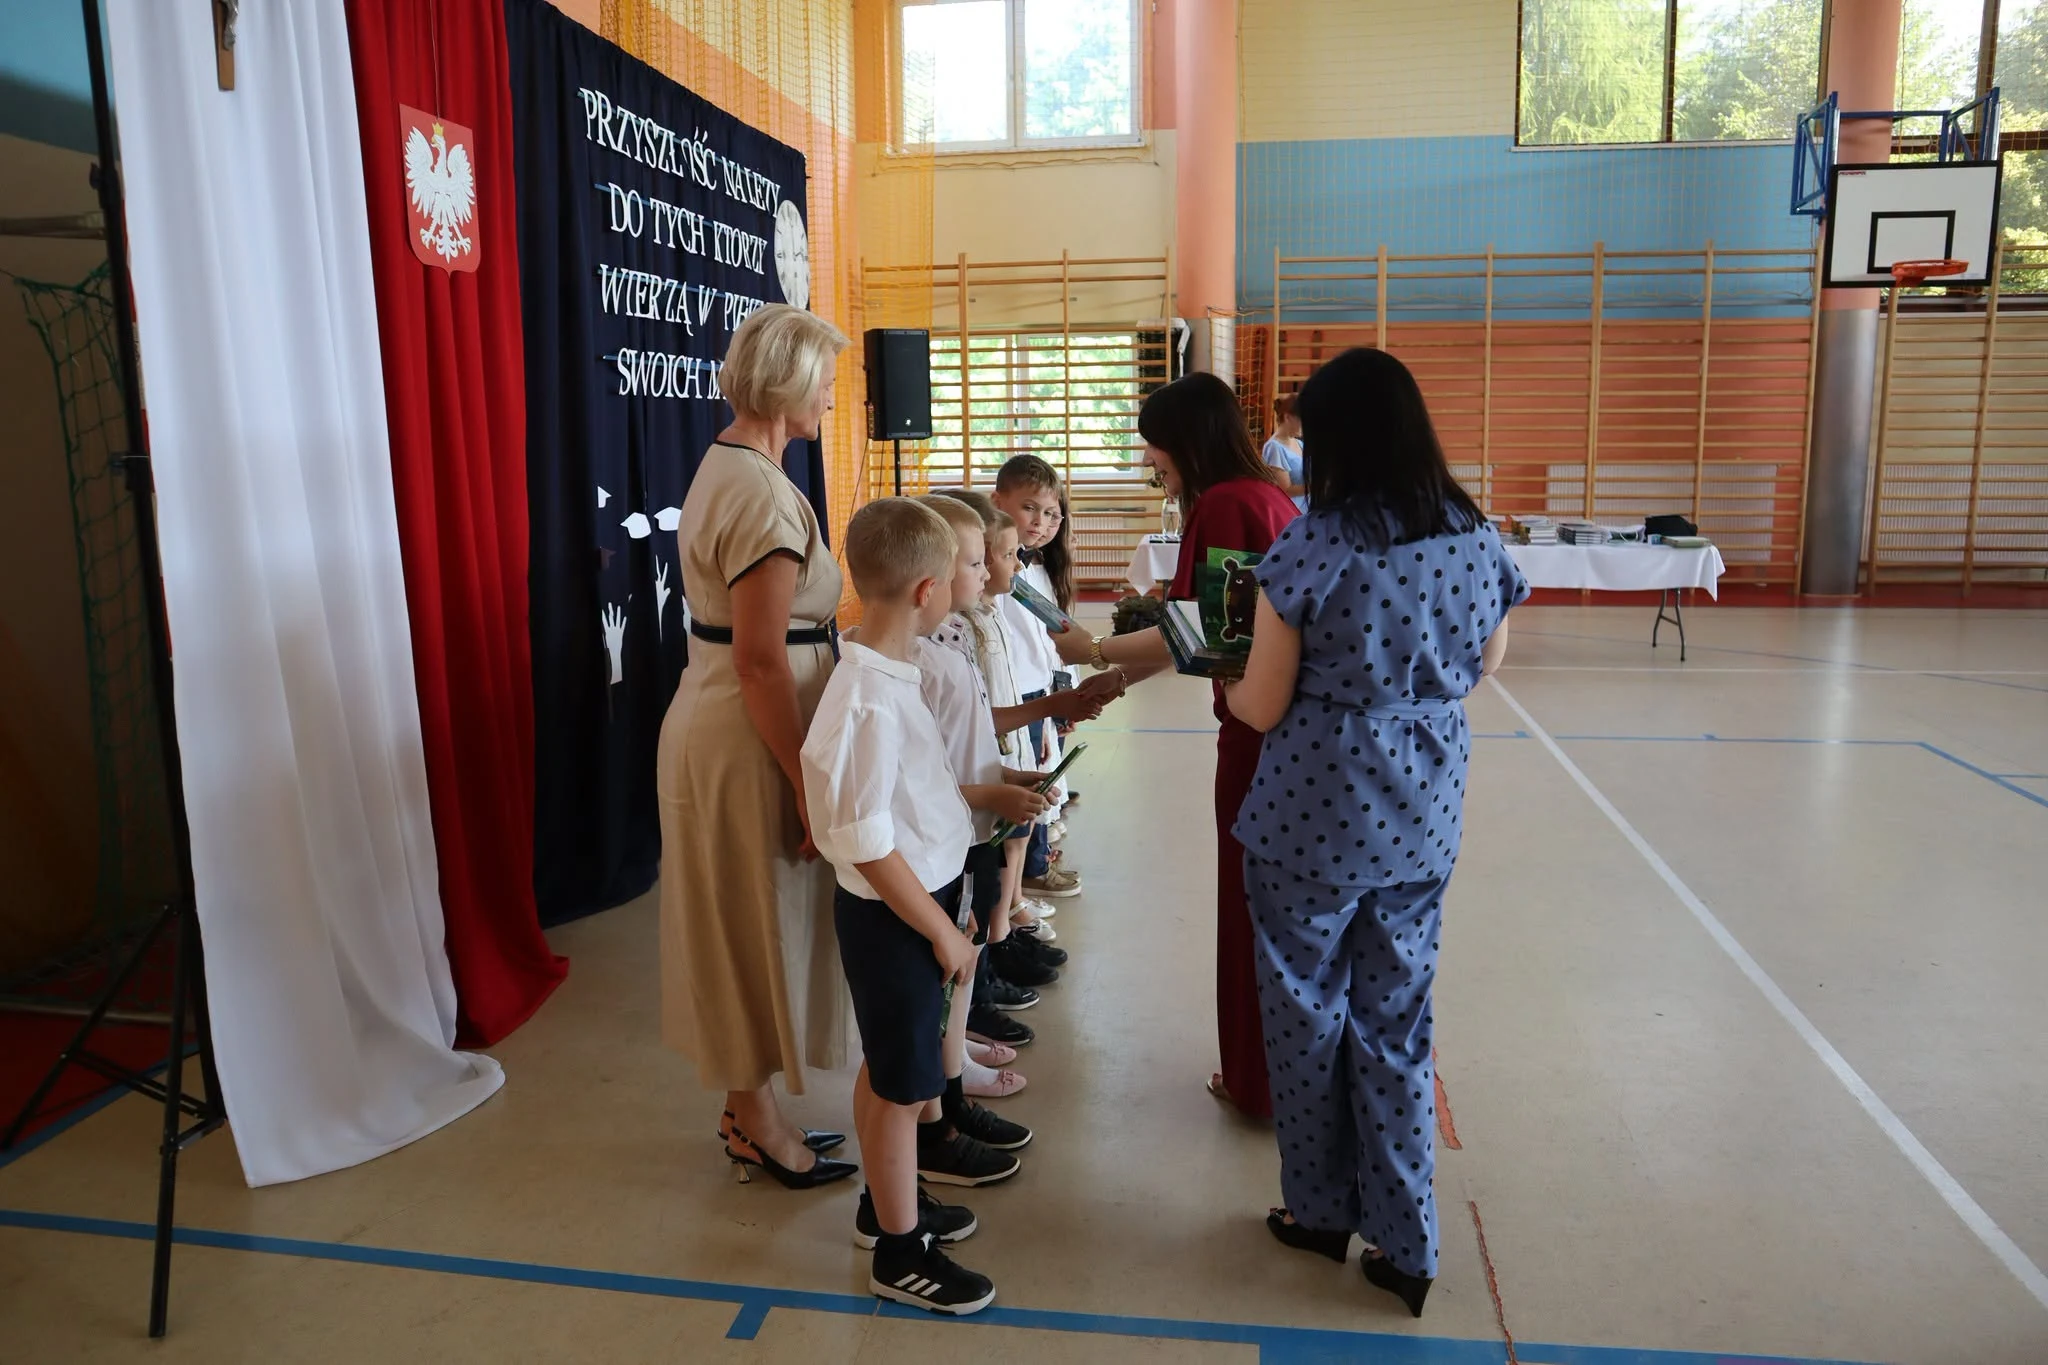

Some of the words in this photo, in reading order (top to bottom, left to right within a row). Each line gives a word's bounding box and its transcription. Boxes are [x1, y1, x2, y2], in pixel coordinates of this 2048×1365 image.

[608, 182, 644, 238] DO
[650, 197, 706, 257] TYCH
[600, 264, 694, 337] WIERZĄ
[698, 284, 717, 327] W
[617, 347, 703, 399] SWOICH
